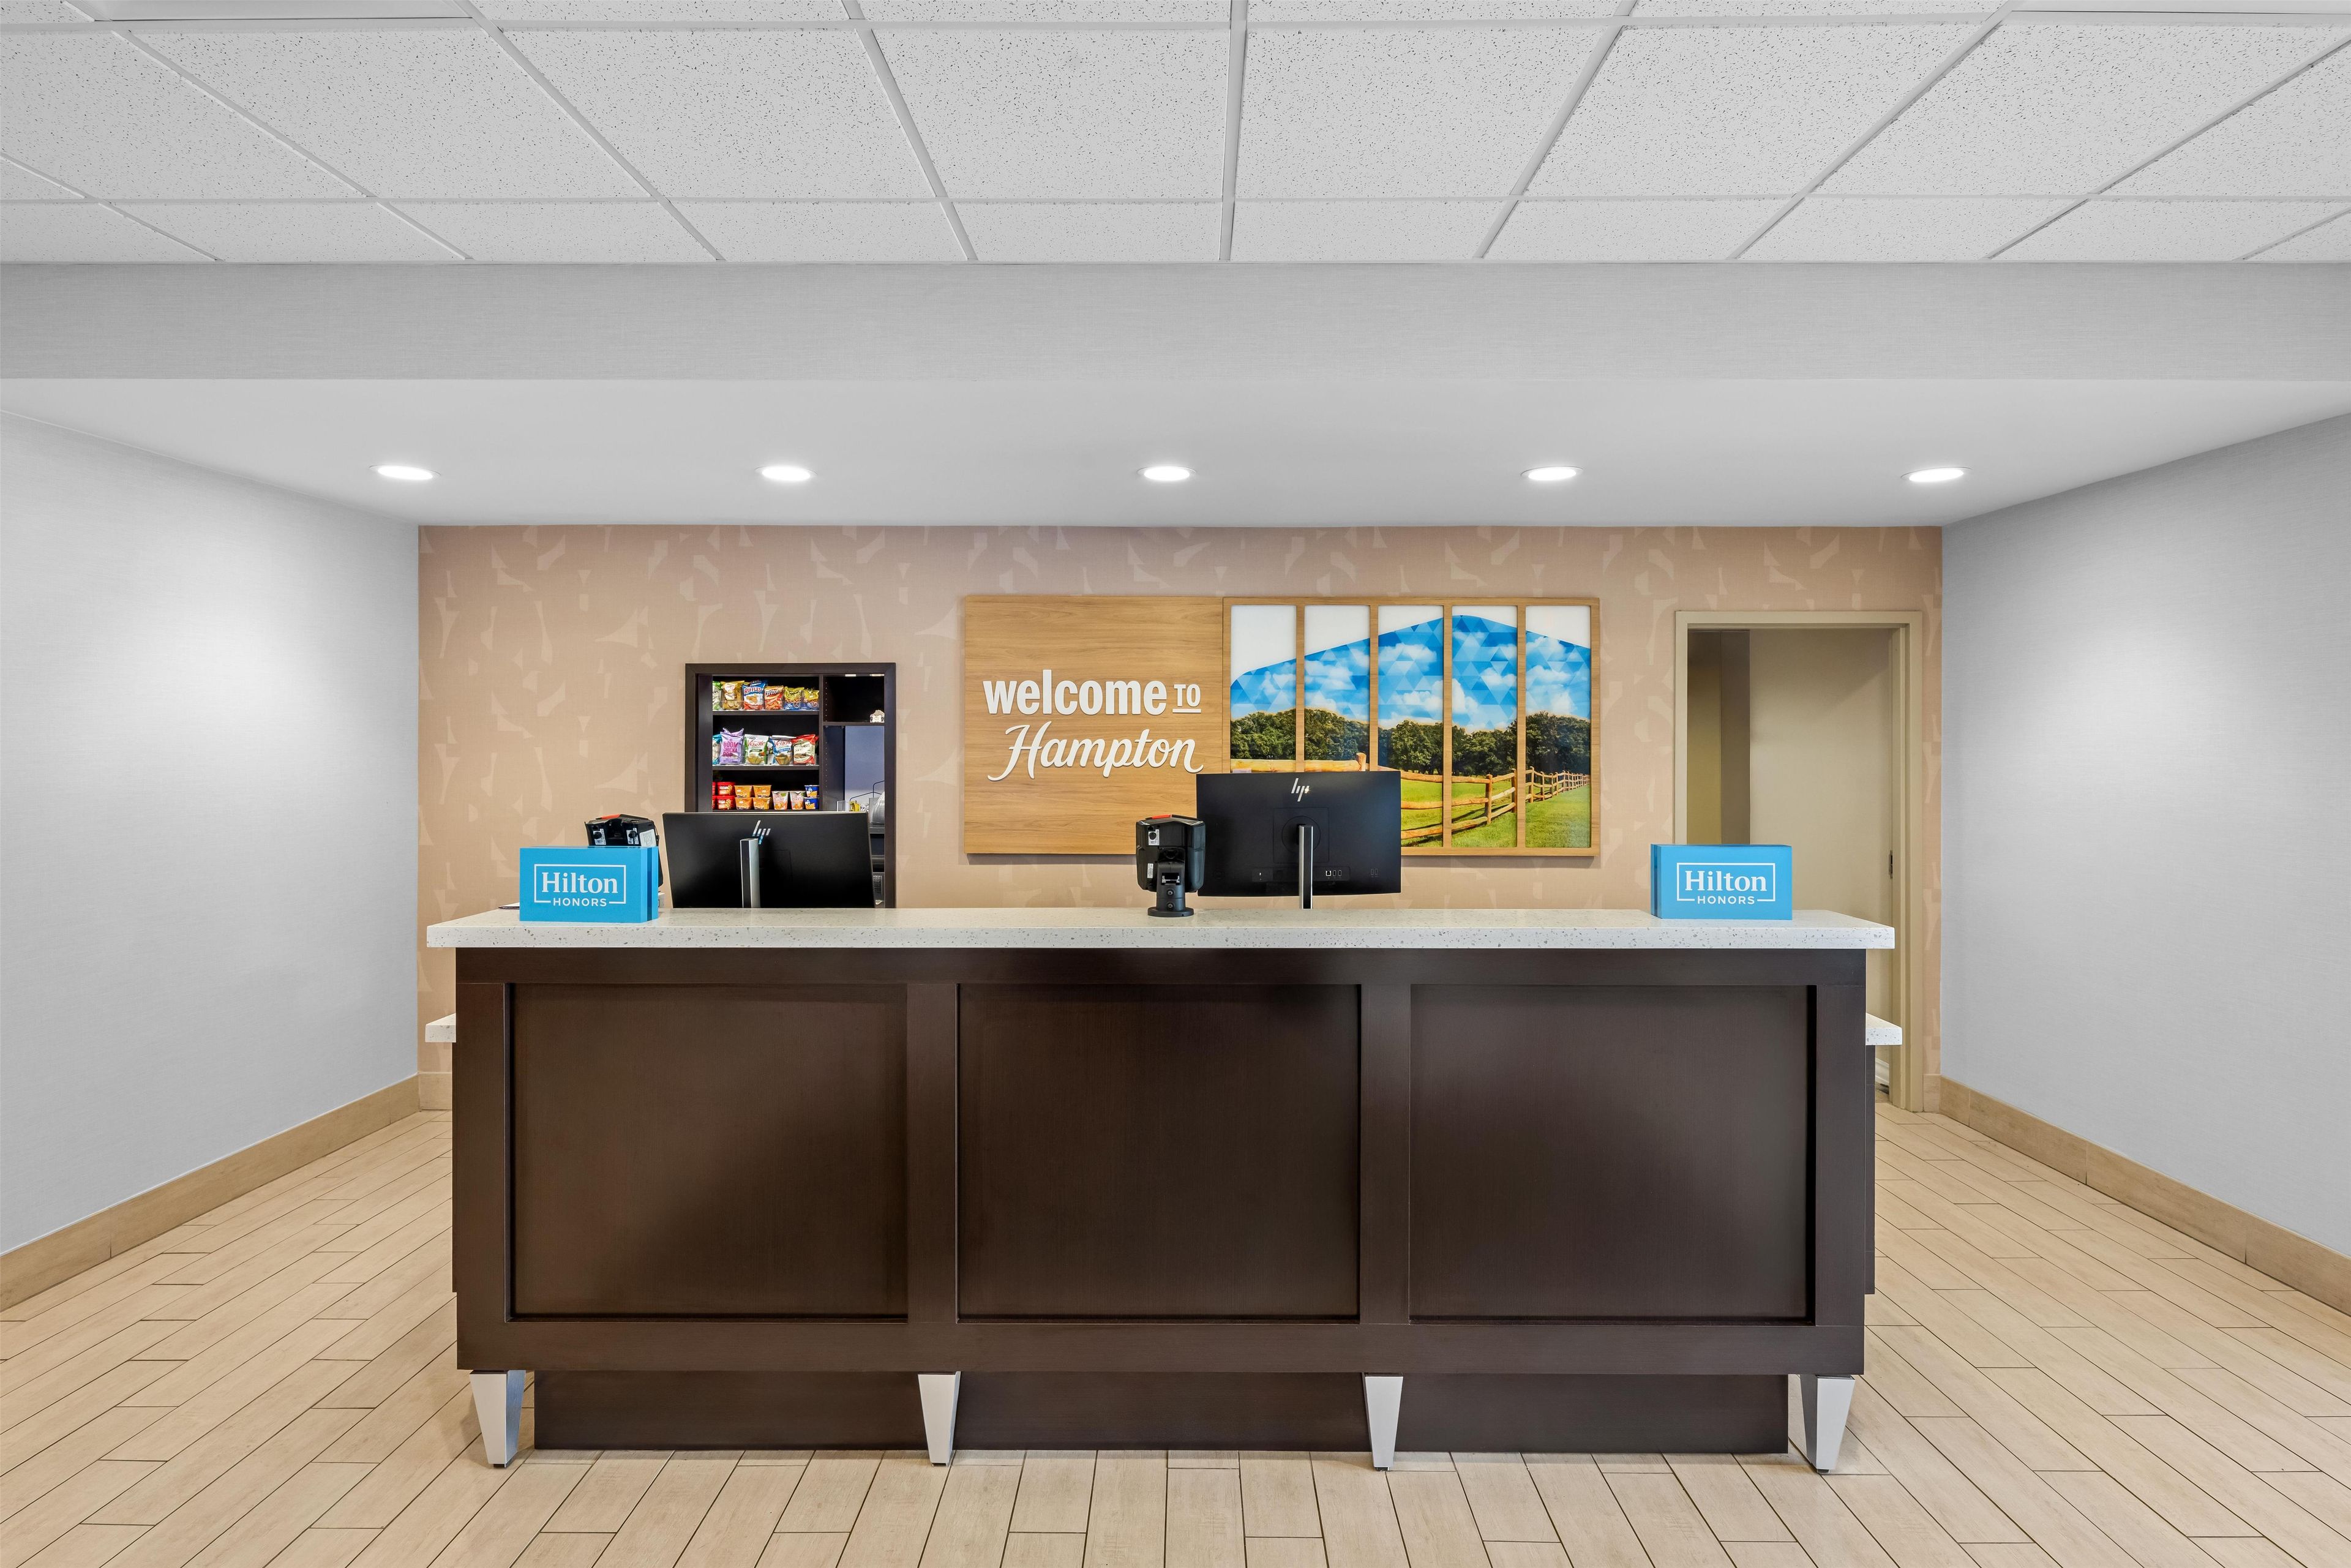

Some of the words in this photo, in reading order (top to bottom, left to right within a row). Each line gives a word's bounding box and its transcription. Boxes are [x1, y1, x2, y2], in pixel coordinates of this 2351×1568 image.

[983, 669, 1167, 715] welcome
[1174, 683, 1201, 707] TO
[987, 721, 1204, 781] Hampton
[1291, 778, 1310, 802] hp
[752, 820, 771, 845] hp
[541, 872, 619, 894] Hilton
[1684, 870, 1768, 892] Hilton
[553, 897, 607, 907] HONORS
[1697, 896, 1755, 904] HONORS
